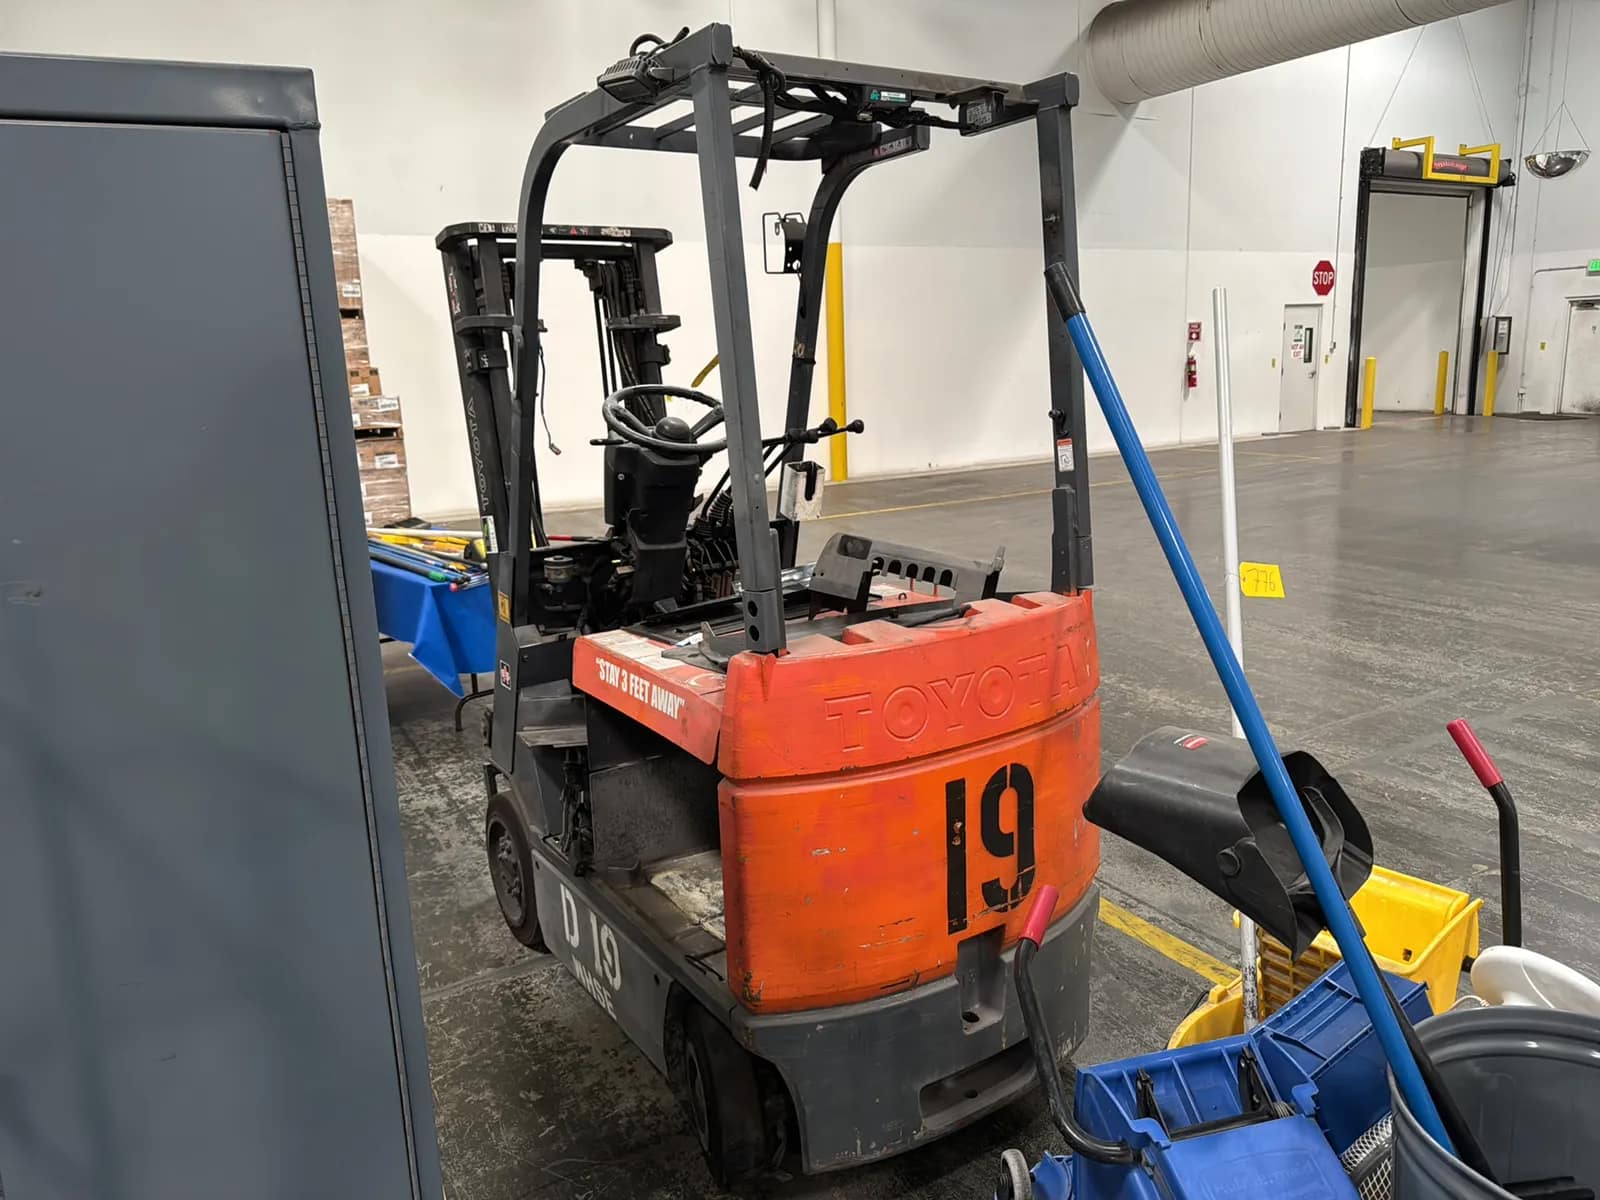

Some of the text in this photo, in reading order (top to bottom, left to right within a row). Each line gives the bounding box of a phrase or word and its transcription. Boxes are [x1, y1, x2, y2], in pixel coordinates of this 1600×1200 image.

[1313, 271, 1334, 285] STOP
[467, 396, 489, 511] TOYOTA
[1247, 568, 1275, 592] 776
[621, 669, 628, 693] 3
[629, 672, 650, 704] FEET
[824, 643, 1081, 753] TOYOTA
[945, 762, 1036, 935] 19
[560, 883, 622, 991] D 19
